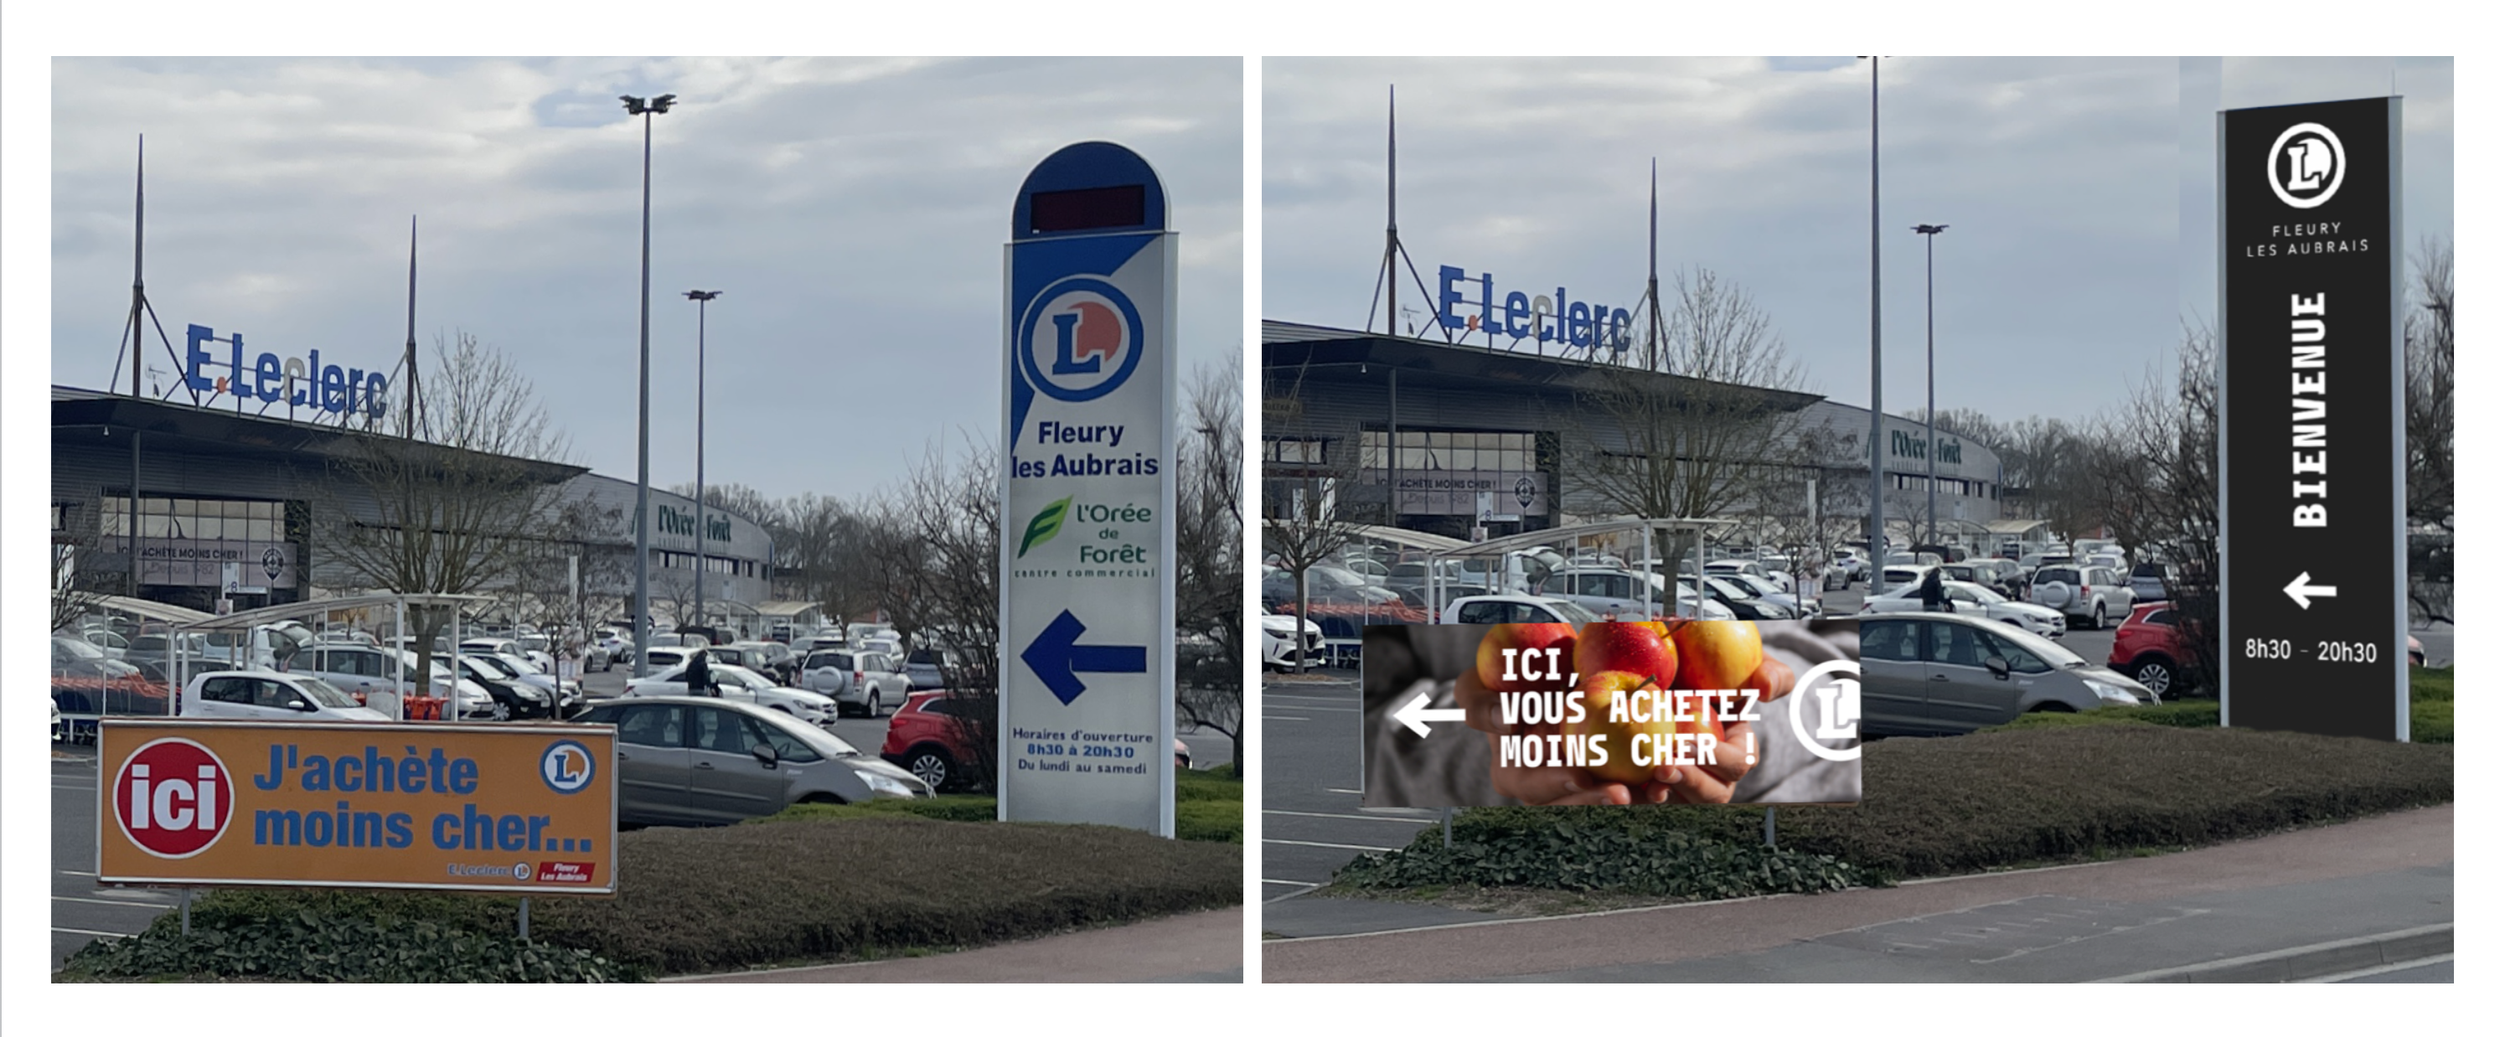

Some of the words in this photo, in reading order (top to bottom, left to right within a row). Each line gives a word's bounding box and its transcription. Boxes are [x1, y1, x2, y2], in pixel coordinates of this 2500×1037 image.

[2272, 222, 2342, 237] FLEURY
[2247, 243, 2277, 257] LES
[2287, 239, 2369, 255] AUBRAIS
[1439, 265, 1631, 352] E.Leclerc
[187, 323, 388, 418] E.Leclerc
[2291, 292, 2327, 527] BIENVENUE
[1038, 421, 1124, 447] Fleury
[1011, 456, 1046, 478] les
[1051, 453, 1159, 477] Aubrais
[1435, 479, 1466, 489] MONS
[1076, 503, 1152, 523] l'Orée
[1098, 527, 1119, 540] de
[179, 548, 211, 559] MONS
[212, 549, 238, 560] CHER
[1080, 544, 1147, 564] Forêt
[1014, 569, 1057, 578] centre
[1066, 568, 1155, 578] commercial
[2245, 638, 2291, 660] 8h30
[2317, 640, 2377, 663] 20h30
[1501, 647, 1580, 690] ICI,
[1500, 691, 1586, 725] VOUS
[1608, 688, 1762, 724] ACHETEZ
[1013, 727, 1066, 741] Horaires
[1071, 729, 1153, 743] d'ouverture
[1027, 743, 1064, 756] 8h30
[1068, 744, 1078, 756] à
[1083, 745, 1134, 759] 20h30
[1500, 733, 1609, 768] MOINS
[1631, 732, 1717, 767] CHER
[253, 743, 479, 795] J'achète
[1018, 758, 1035, 770] Du
[1039, 759, 1070, 772] lundi
[1076, 763, 1091, 773] au
[1097, 762, 1147, 774] samedi
[131, 764, 216, 831] ici
[254, 801, 414, 849] moins
[431, 803, 592, 853] cher...
[553, 863, 580, 873] Fleury
[556, 872, 588, 881] Aubrais
